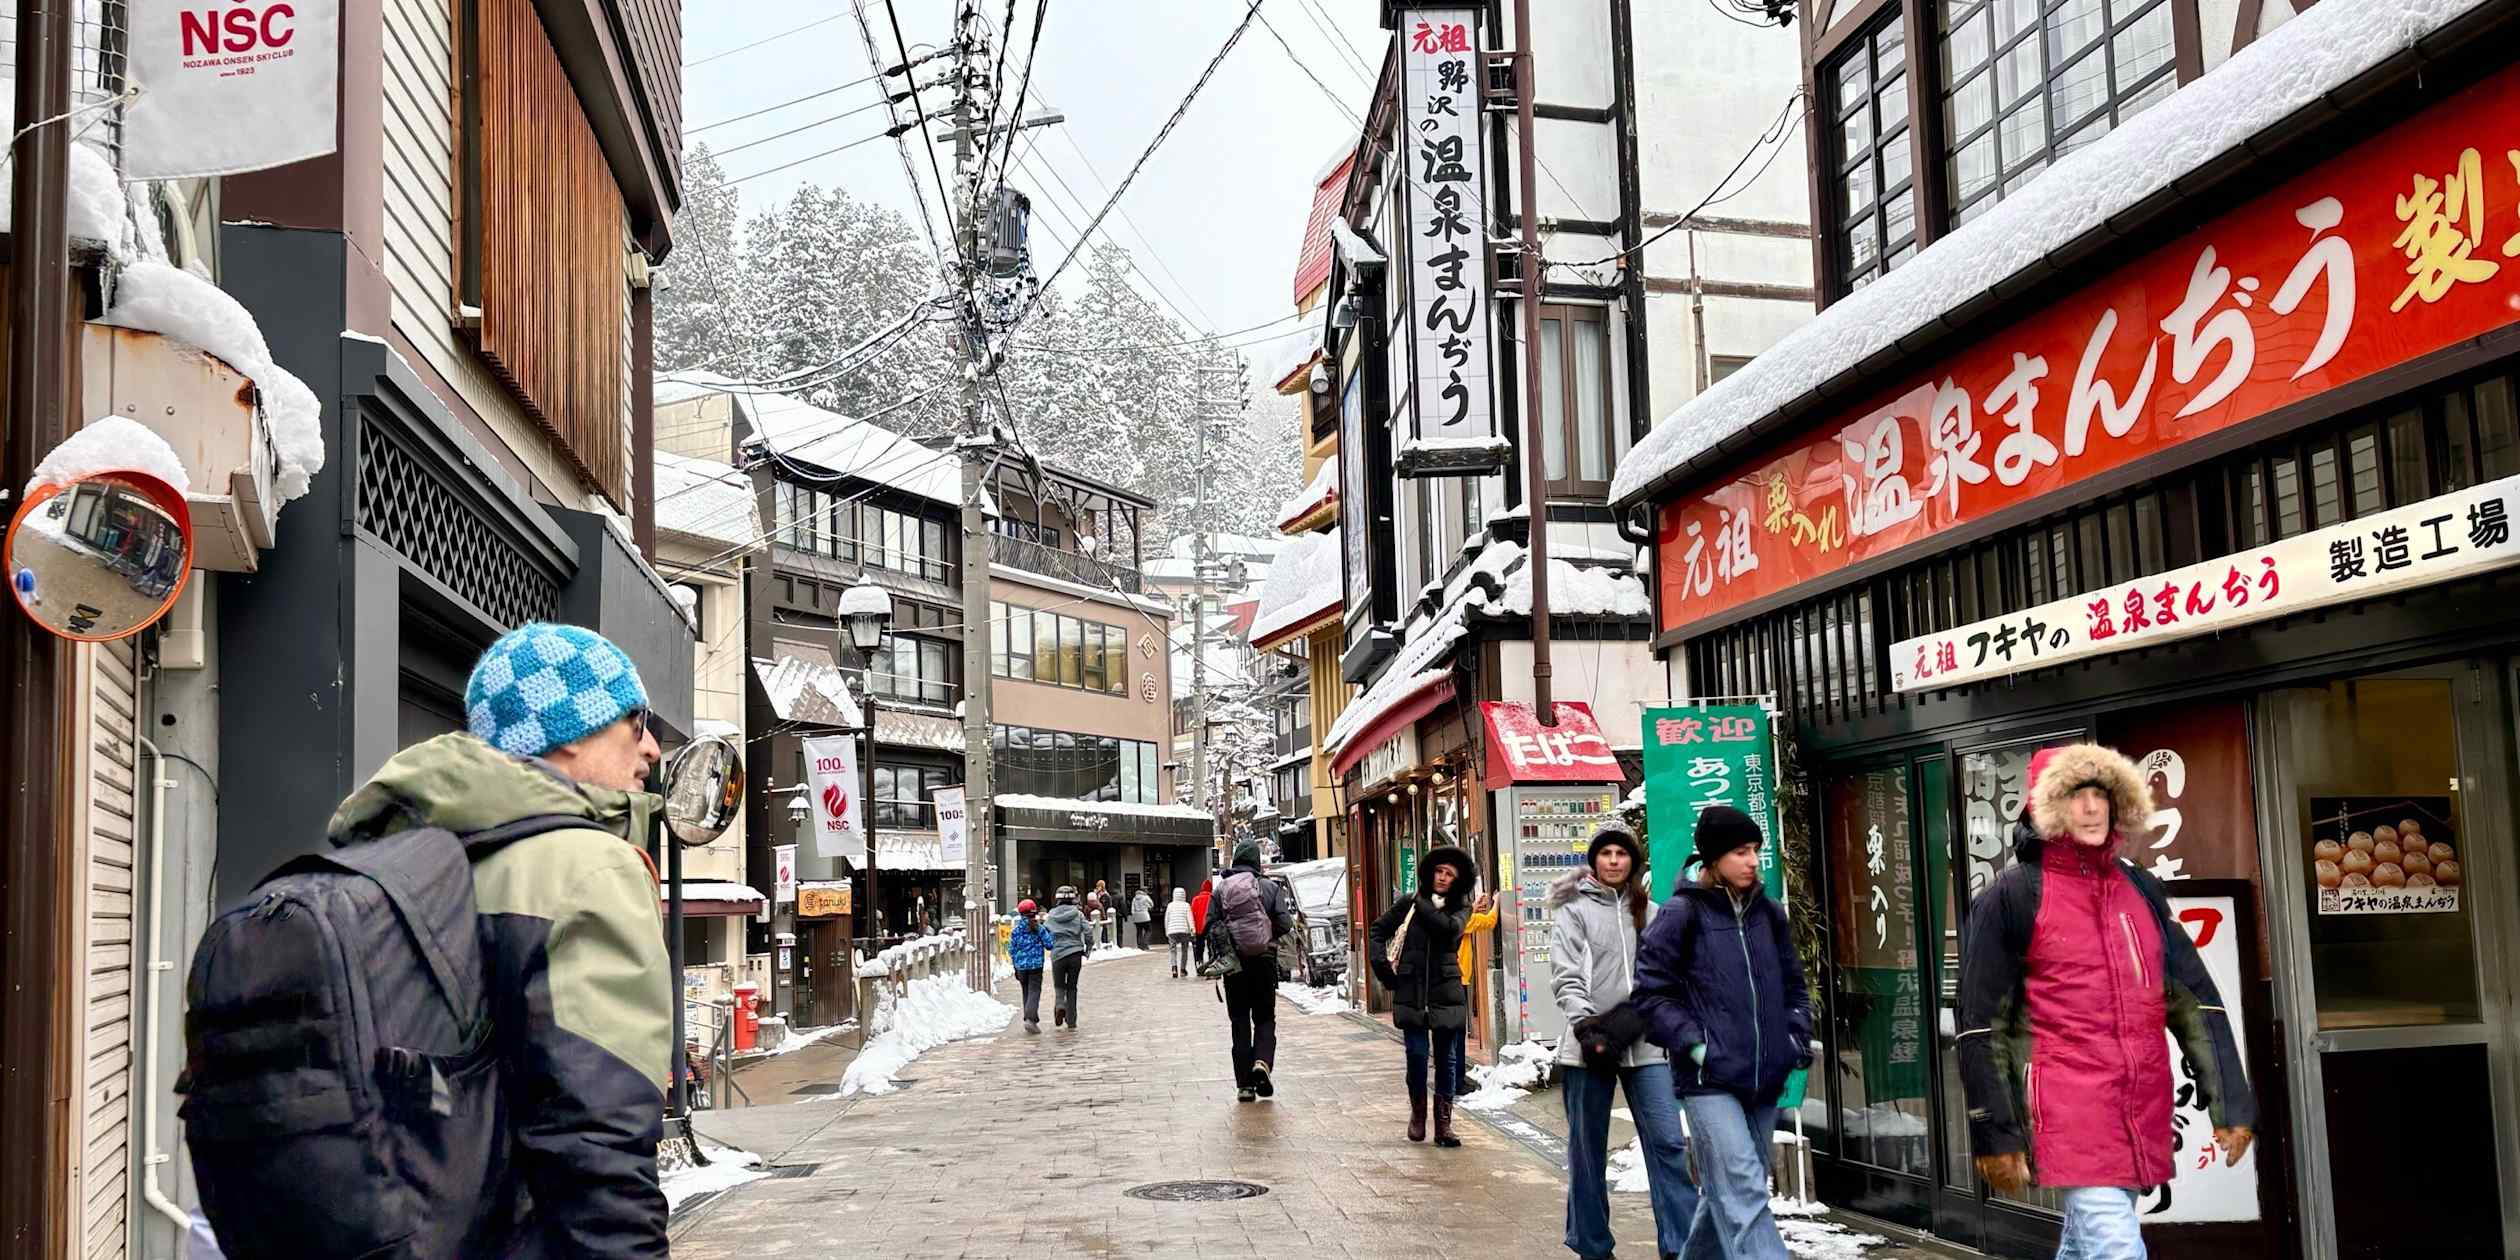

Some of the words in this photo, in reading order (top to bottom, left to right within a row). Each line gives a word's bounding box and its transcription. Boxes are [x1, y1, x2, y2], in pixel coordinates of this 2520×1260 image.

[180, 4, 295, 56] NSC
[1411, 22, 1472, 54] 元祖
[183, 56, 222, 69] NOZAWA
[224, 55, 254, 65] ONSEN
[256, 53, 271, 62] SKI
[272, 49, 294, 60] CLUB
[236, 67, 255, 76] 1923
[1420, 59, 1476, 427] 野沢の温泉まんぢう
[1680, 507, 1760, 601] 元祖
[1842, 196, 2357, 537] 温泉まんぢう
[2389, 147, 2520, 313] 製
[1911, 640, 1959, 680] 元祖
[1967, 616, 2071, 667] フキヤの
[2086, 556, 2280, 642] 温泉まんぢう
[2329, 497, 2508, 583] 製造工場
[1655, 716, 1757, 747] 歓迎
[1500, 730, 1617, 766] たばこ
[816, 757, 842, 772] 100
[827, 820, 850, 831] NSC
[939, 810, 959, 821] 100
